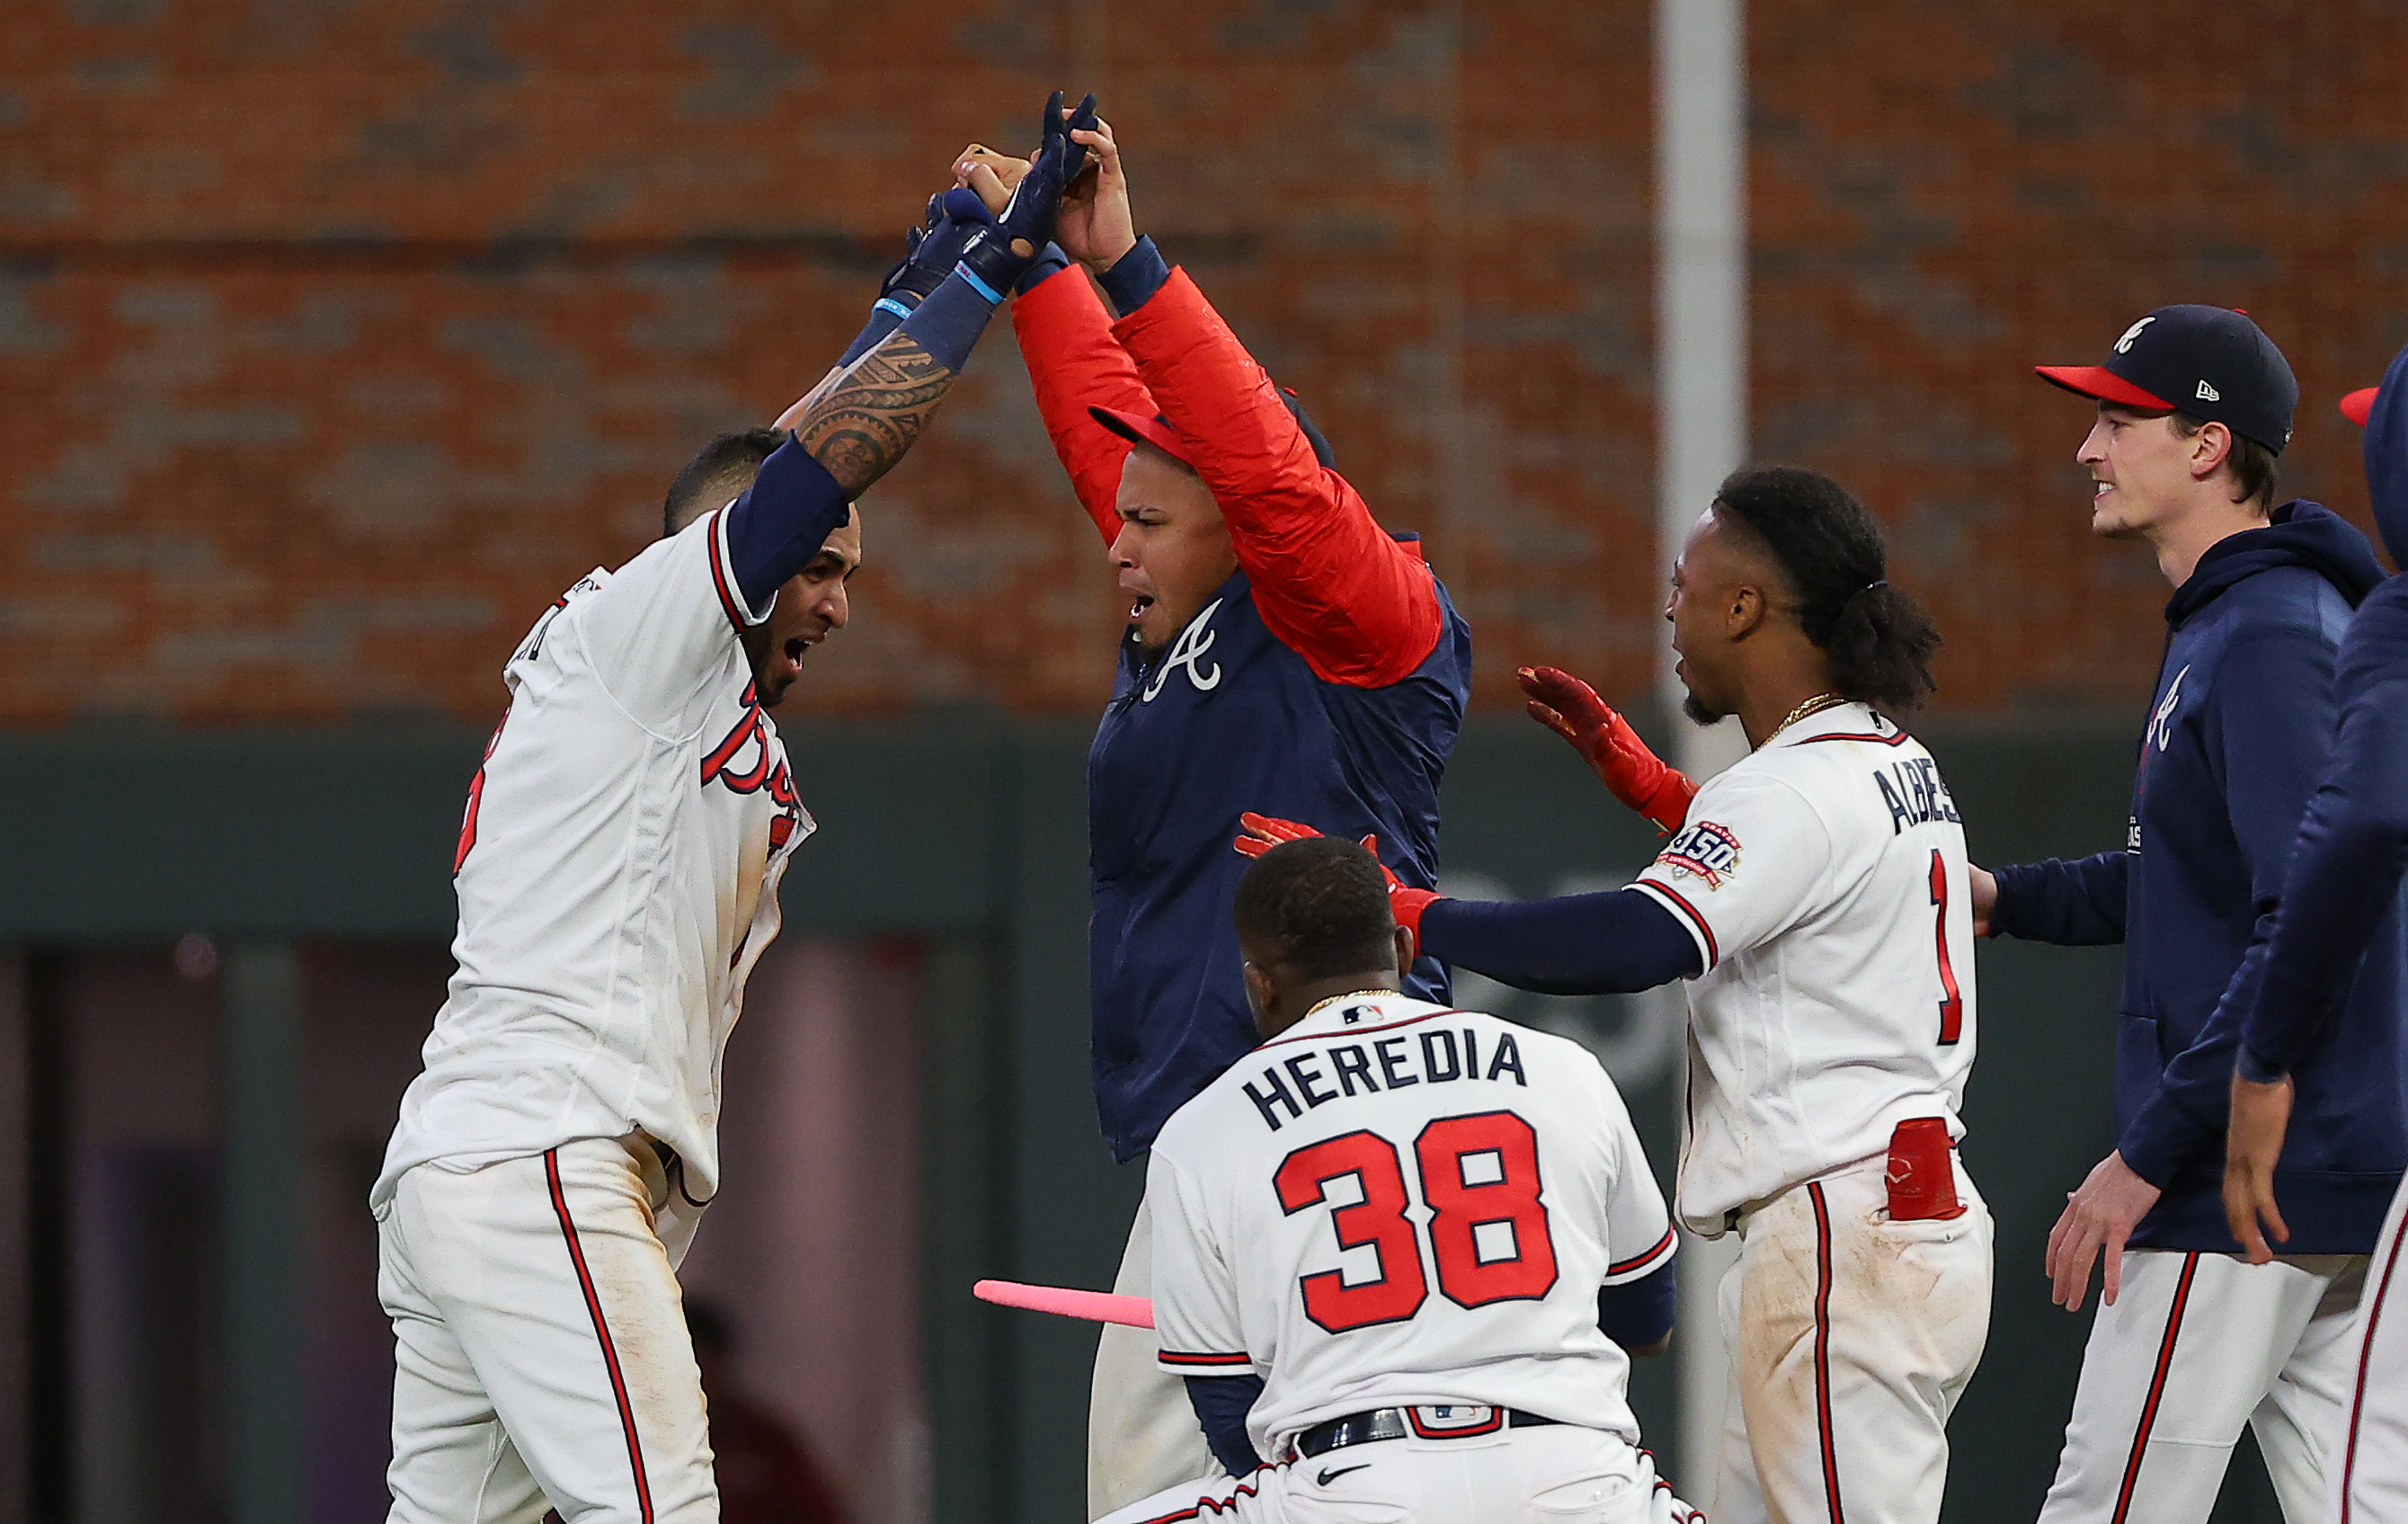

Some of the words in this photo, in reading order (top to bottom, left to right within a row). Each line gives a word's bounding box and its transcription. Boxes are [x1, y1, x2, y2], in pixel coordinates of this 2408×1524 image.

[1142, 596, 1223, 703] A
[1669, 826, 1737, 870] 150
[1930, 849, 1963, 1046] 1
[1242, 1029, 1527, 1132] HEREDIA
[1272, 1109, 1559, 1335] 38
